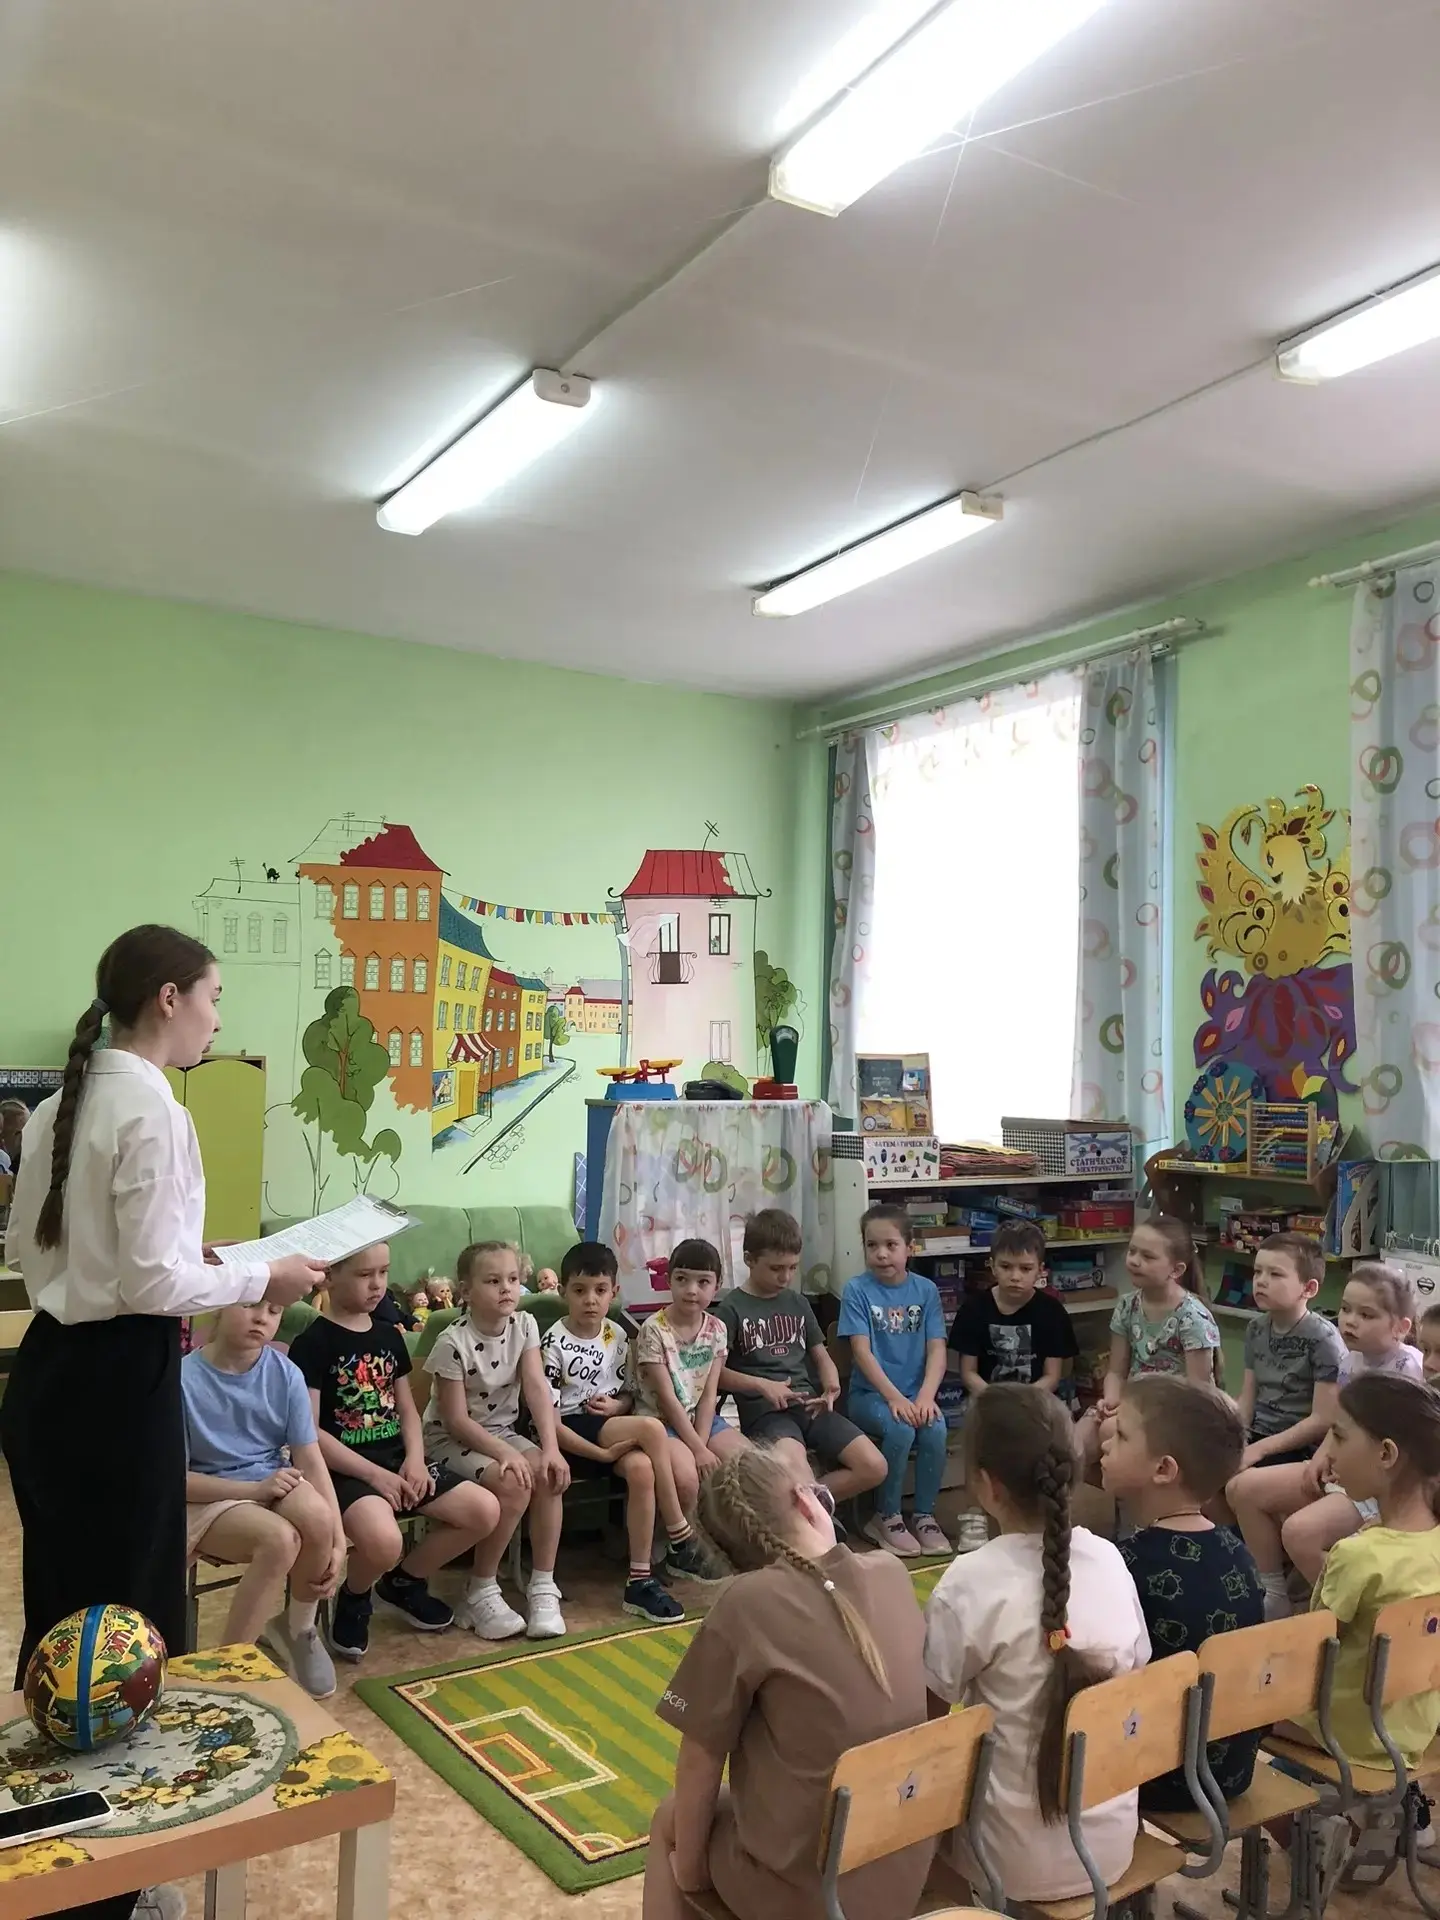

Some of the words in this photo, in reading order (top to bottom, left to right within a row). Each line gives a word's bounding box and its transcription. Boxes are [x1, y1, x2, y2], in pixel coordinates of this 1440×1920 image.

[873, 1140, 932, 1148] МАТЕМТИЧЕСКЙ
[932, 1138, 939, 1150] 6
[891, 1153, 897, 1164] 2
[915, 1156, 921, 1168] 1
[1070, 1156, 1128, 1167] СТАТИЧЕСКОЕ
[881, 1166, 888, 1177] 3
[925, 1165, 931, 1176] 4
[560, 1335, 604, 1366] Looking
[1264, 1673, 1272, 1685] 2
[1129, 1721, 1137, 1735] 2
[906, 1785, 914, 1799] 2
